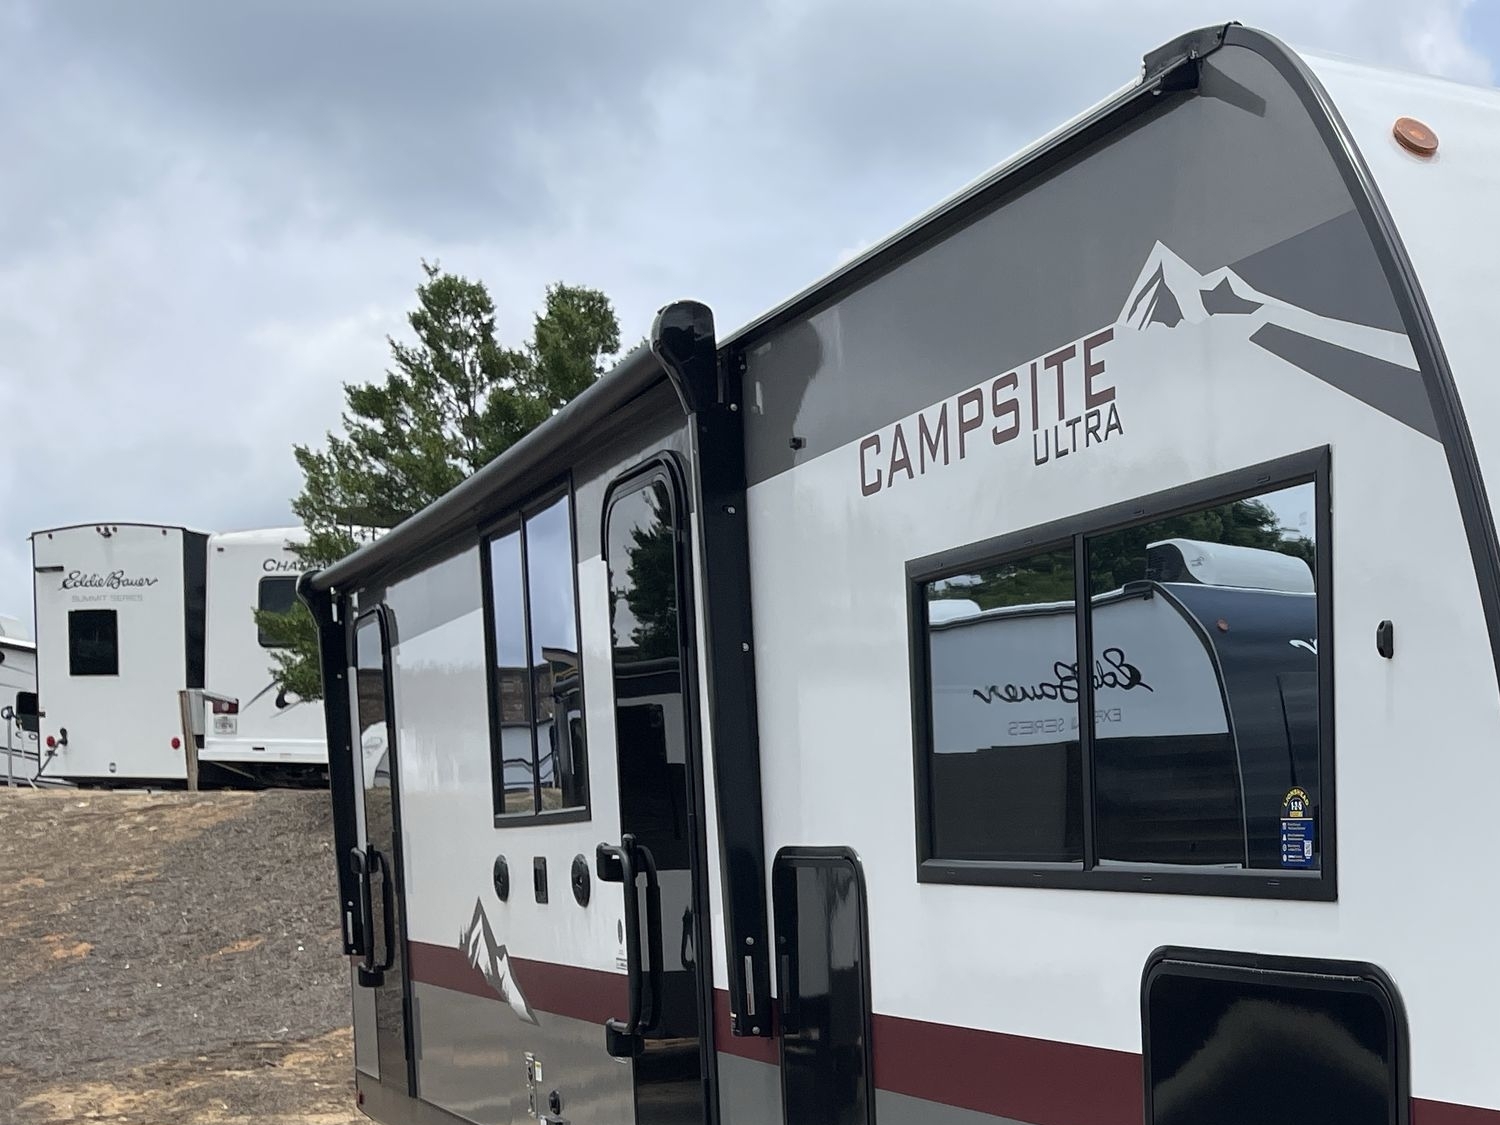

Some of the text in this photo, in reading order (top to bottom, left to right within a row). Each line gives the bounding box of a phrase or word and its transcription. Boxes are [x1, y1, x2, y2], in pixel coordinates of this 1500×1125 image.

[859, 327, 1117, 497] CAMPSITE
[1033, 401, 1125, 467] ULTRA
[59, 569, 159, 591] Eddie Bauer
